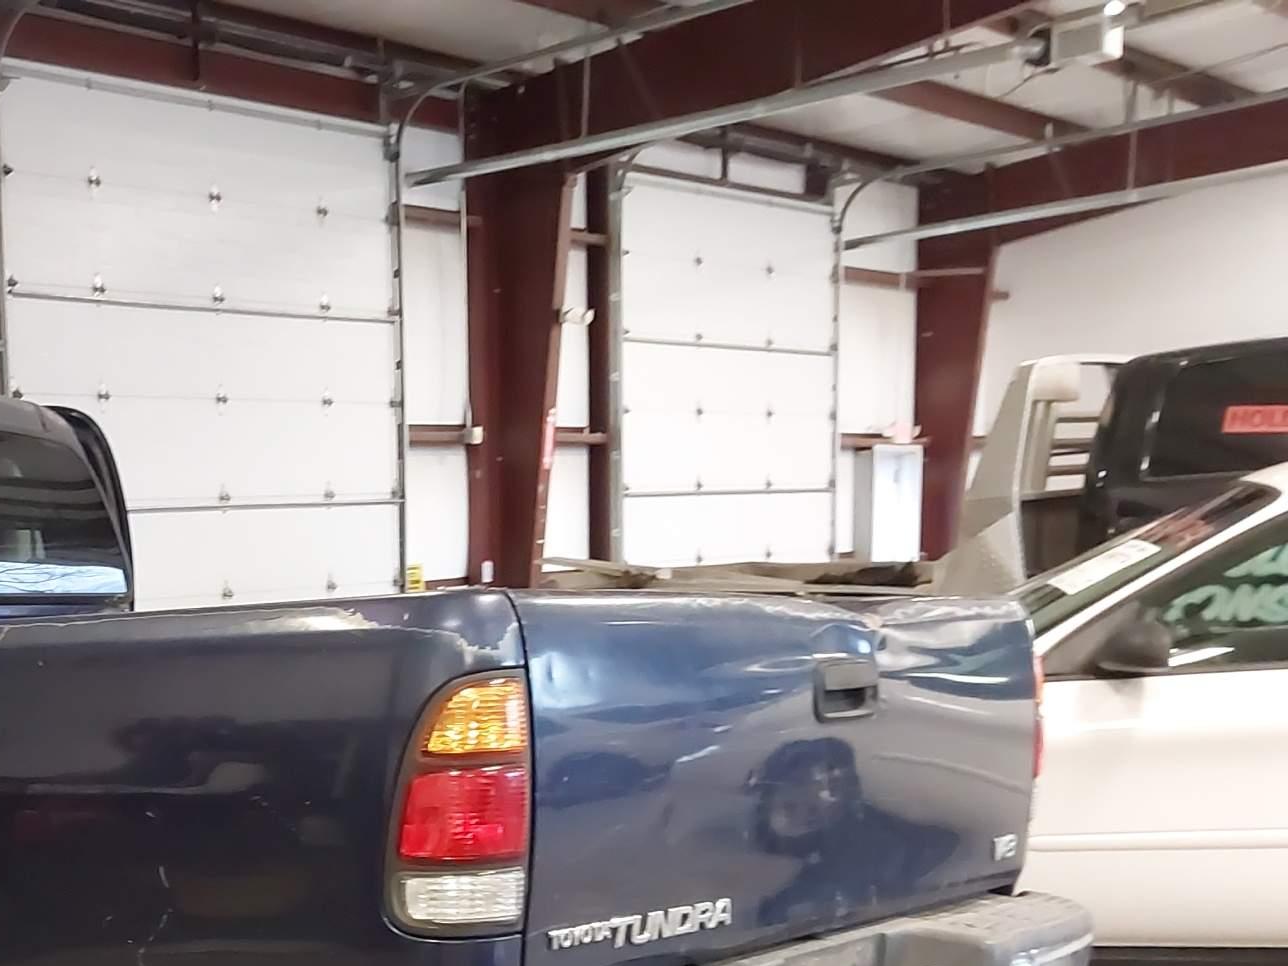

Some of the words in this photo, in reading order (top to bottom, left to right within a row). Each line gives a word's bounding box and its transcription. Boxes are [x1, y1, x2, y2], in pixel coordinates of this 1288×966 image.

[1229, 409, 1288, 427] HOL
[547, 921, 613, 951] TOYOTA
[610, 897, 732, 949] TUNDRA
